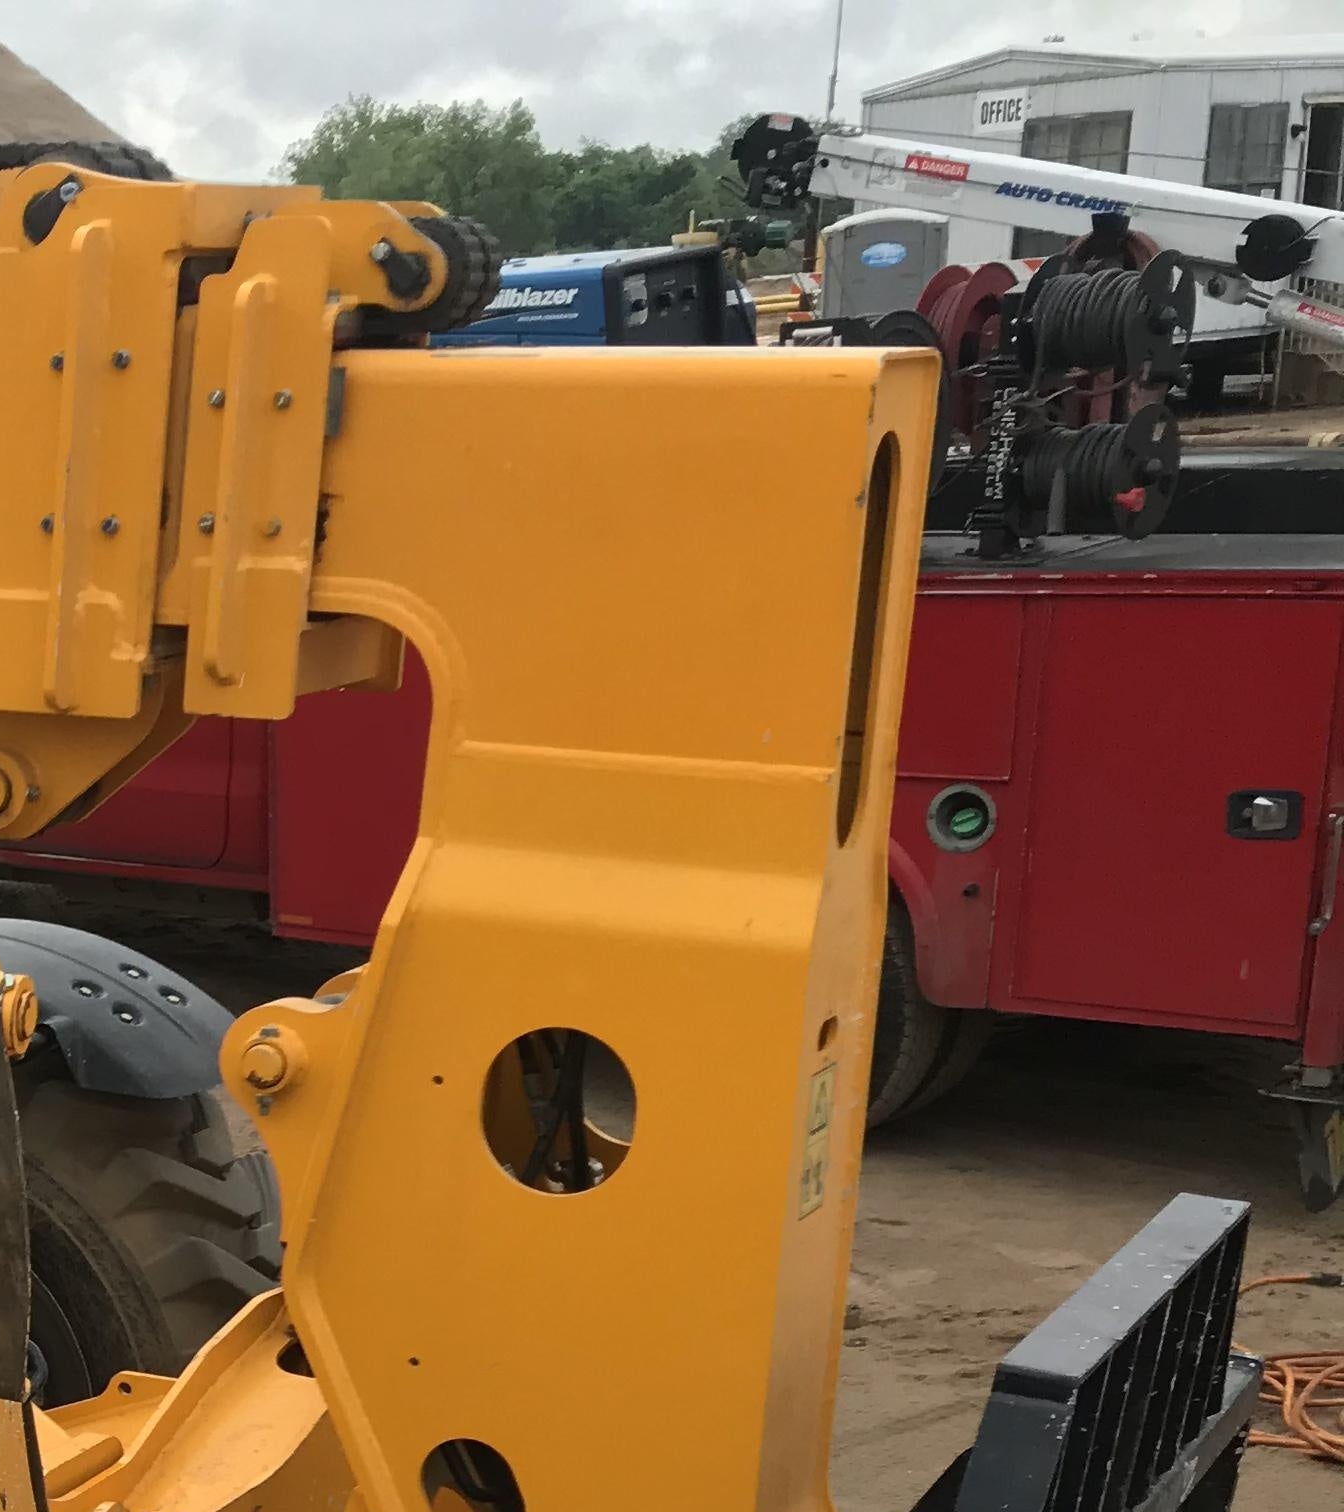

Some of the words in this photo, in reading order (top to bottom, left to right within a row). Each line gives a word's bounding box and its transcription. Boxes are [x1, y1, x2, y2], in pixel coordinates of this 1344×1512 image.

[980, 98, 1023, 125] OFFICE
[920, 160, 966, 177] DANGER
[995, 182, 1053, 202] AUTO
[1055, 191, 1129, 214] CRANE
